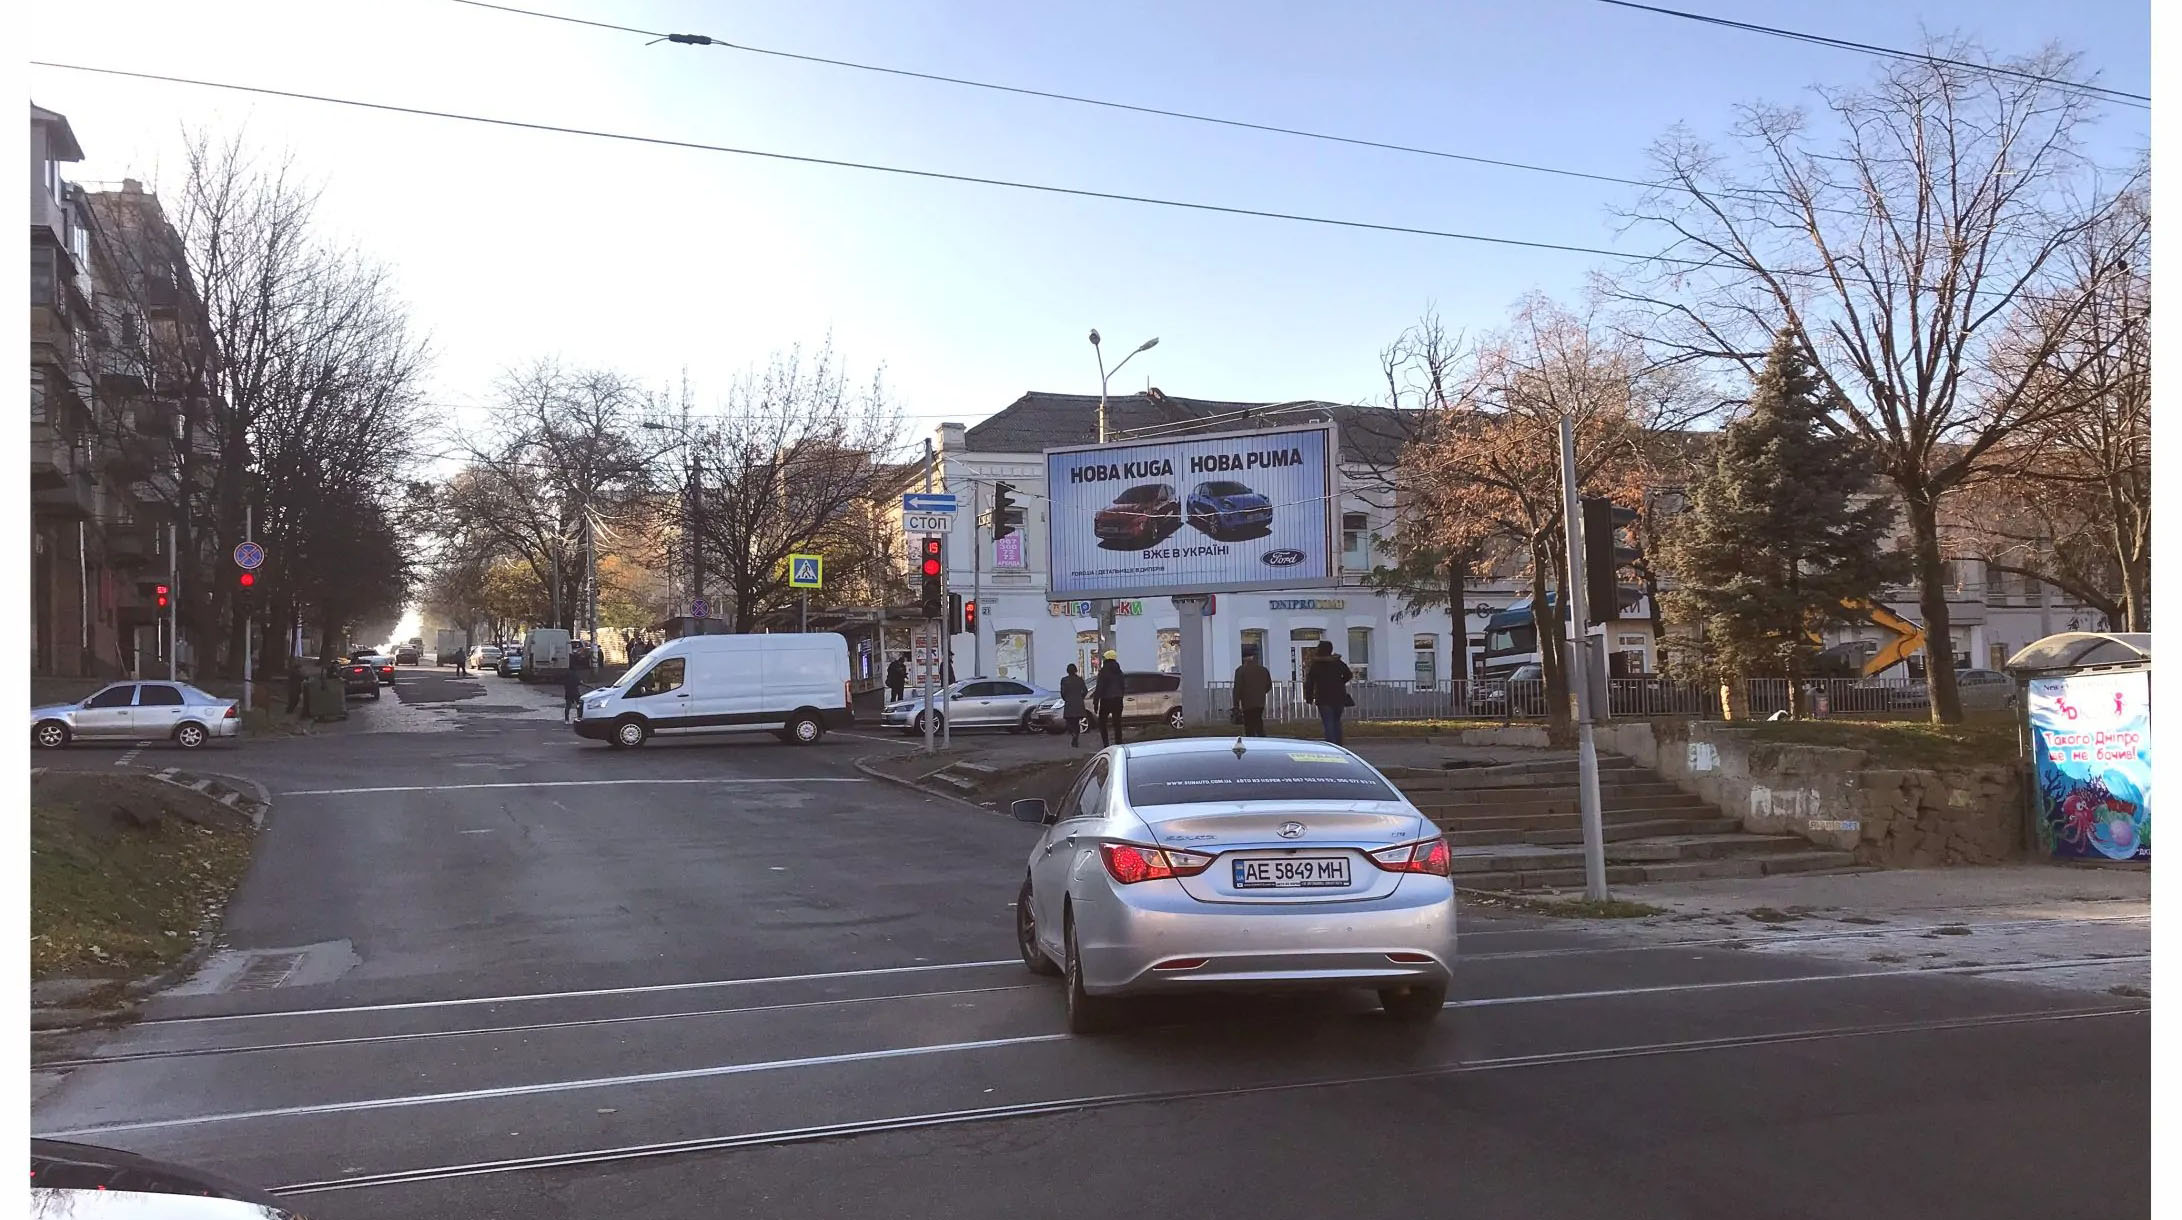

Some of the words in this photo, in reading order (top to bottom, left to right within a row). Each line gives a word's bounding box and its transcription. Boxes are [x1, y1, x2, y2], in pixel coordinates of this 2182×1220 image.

[1191, 453, 1243, 473] НОВА
[1247, 448, 1303, 469] PUMA
[1071, 464, 1120, 484] НОВА
[1124, 459, 1173, 479] KUGA
[910, 516, 947, 529] СТОП
[1143, 549, 1170, 559] ВЖЕ
[1173, 548, 1180, 558] В
[1182, 543, 1229, 558] УКРАЇНІ
[1270, 551, 1298, 564] Ford
[2045, 733, 2090, 745] Такого
[2095, 731, 2140, 746] Дніпро
[2072, 752, 2089, 761] не
[2096, 746, 2136, 761] бачив!
[1246, 863, 1270, 881] AE
[1275, 861, 1314, 880] 5849
[1318, 861, 1343, 879] MH
